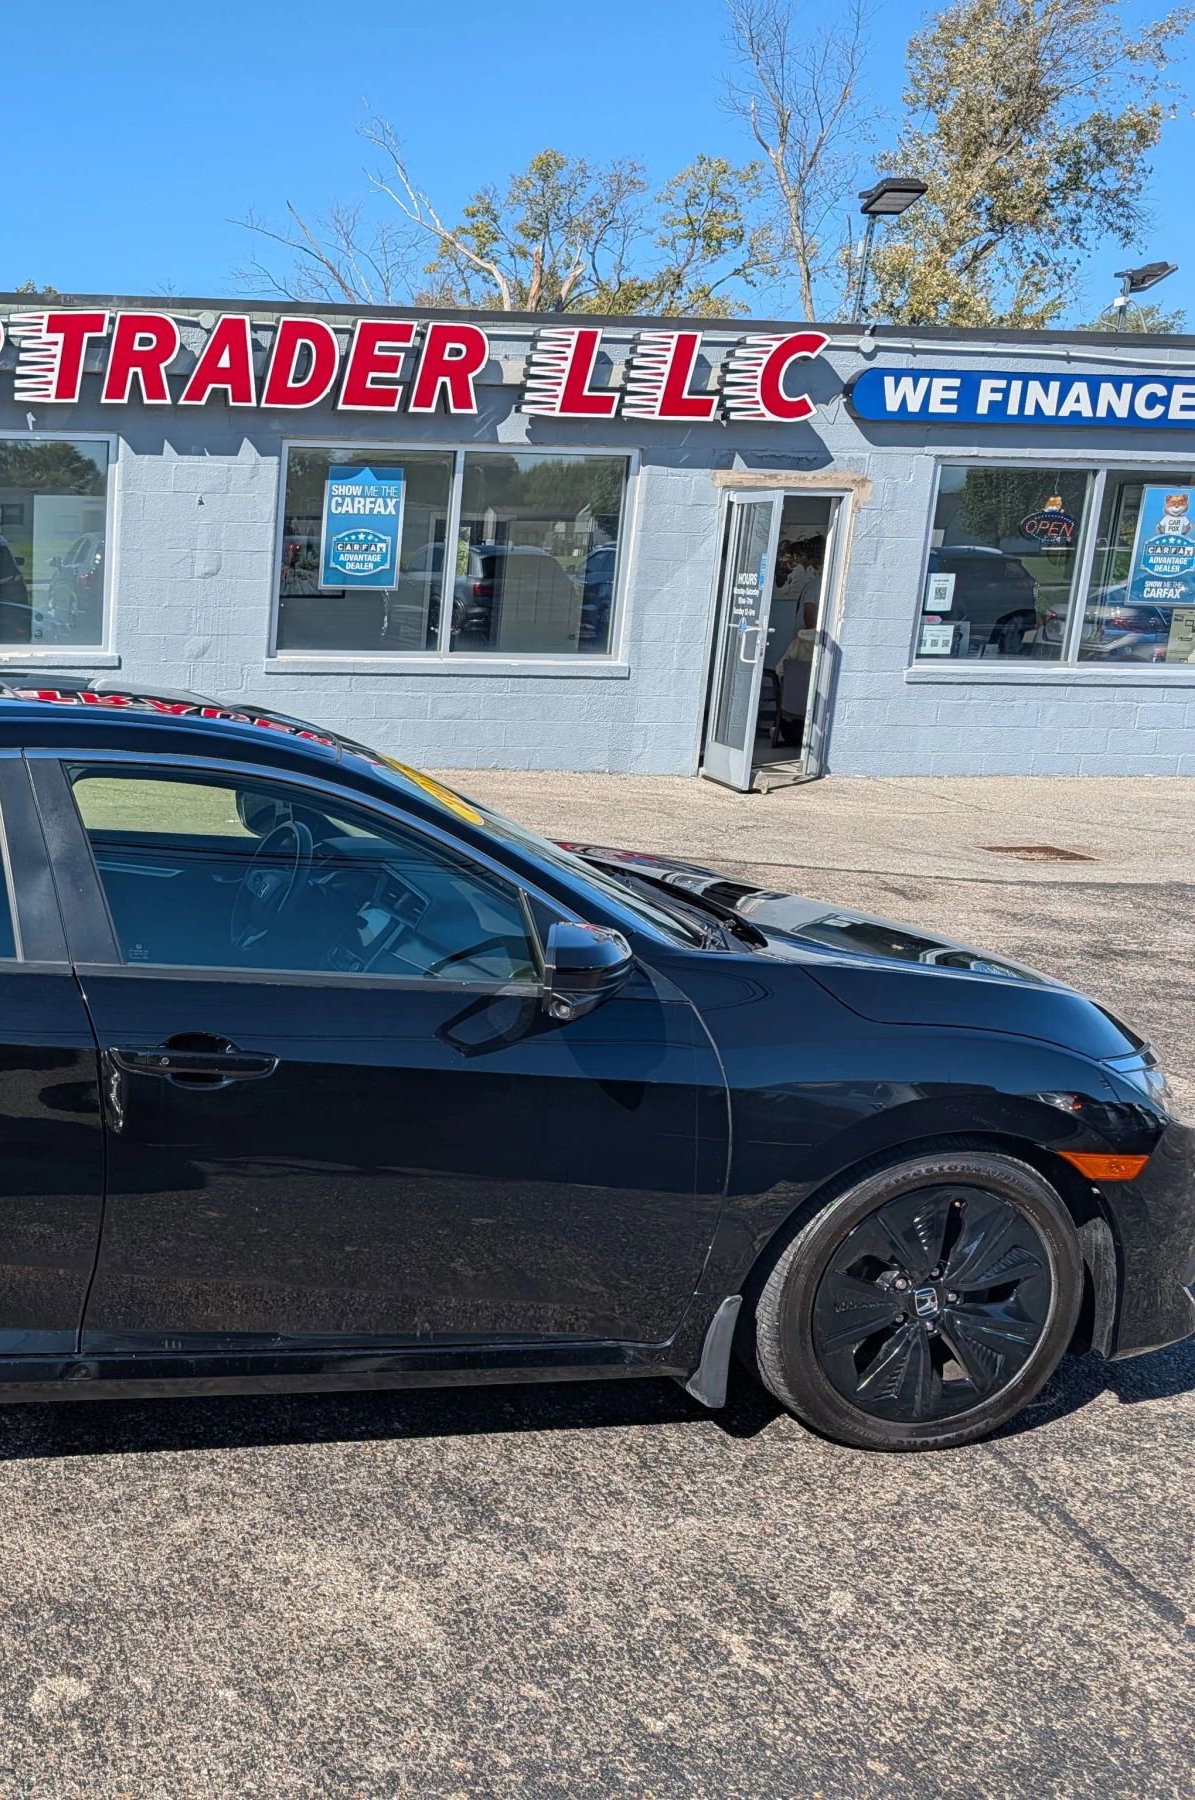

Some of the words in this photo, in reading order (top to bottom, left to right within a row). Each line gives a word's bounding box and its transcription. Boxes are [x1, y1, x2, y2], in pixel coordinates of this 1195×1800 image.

[9, 309, 490, 415] TRADER
[883, 376, 961, 414] WE
[976, 378, 1195, 420] FINANCE
[331, 485, 362, 496] SHOW
[364, 485, 379, 497] ME
[380, 486, 398, 497] THE
[331, 496, 398, 515] CARFAX
[1025, 520, 1074, 537] OPEN
[337, 542, 386, 553] CARFAX
[1148, 546, 1194, 556] CARFAX
[339, 554, 382, 562] ADVANTAGE
[1148, 556, 1189, 565] ADVANTAGE
[345, 562, 374, 570] DEALER
[1154, 565, 1180, 573] DEALER
[738, 572, 758, 586] HOURS
[1144, 580, 1163, 588] SHOW
[1143, 587, 1182, 599] CARFAX
